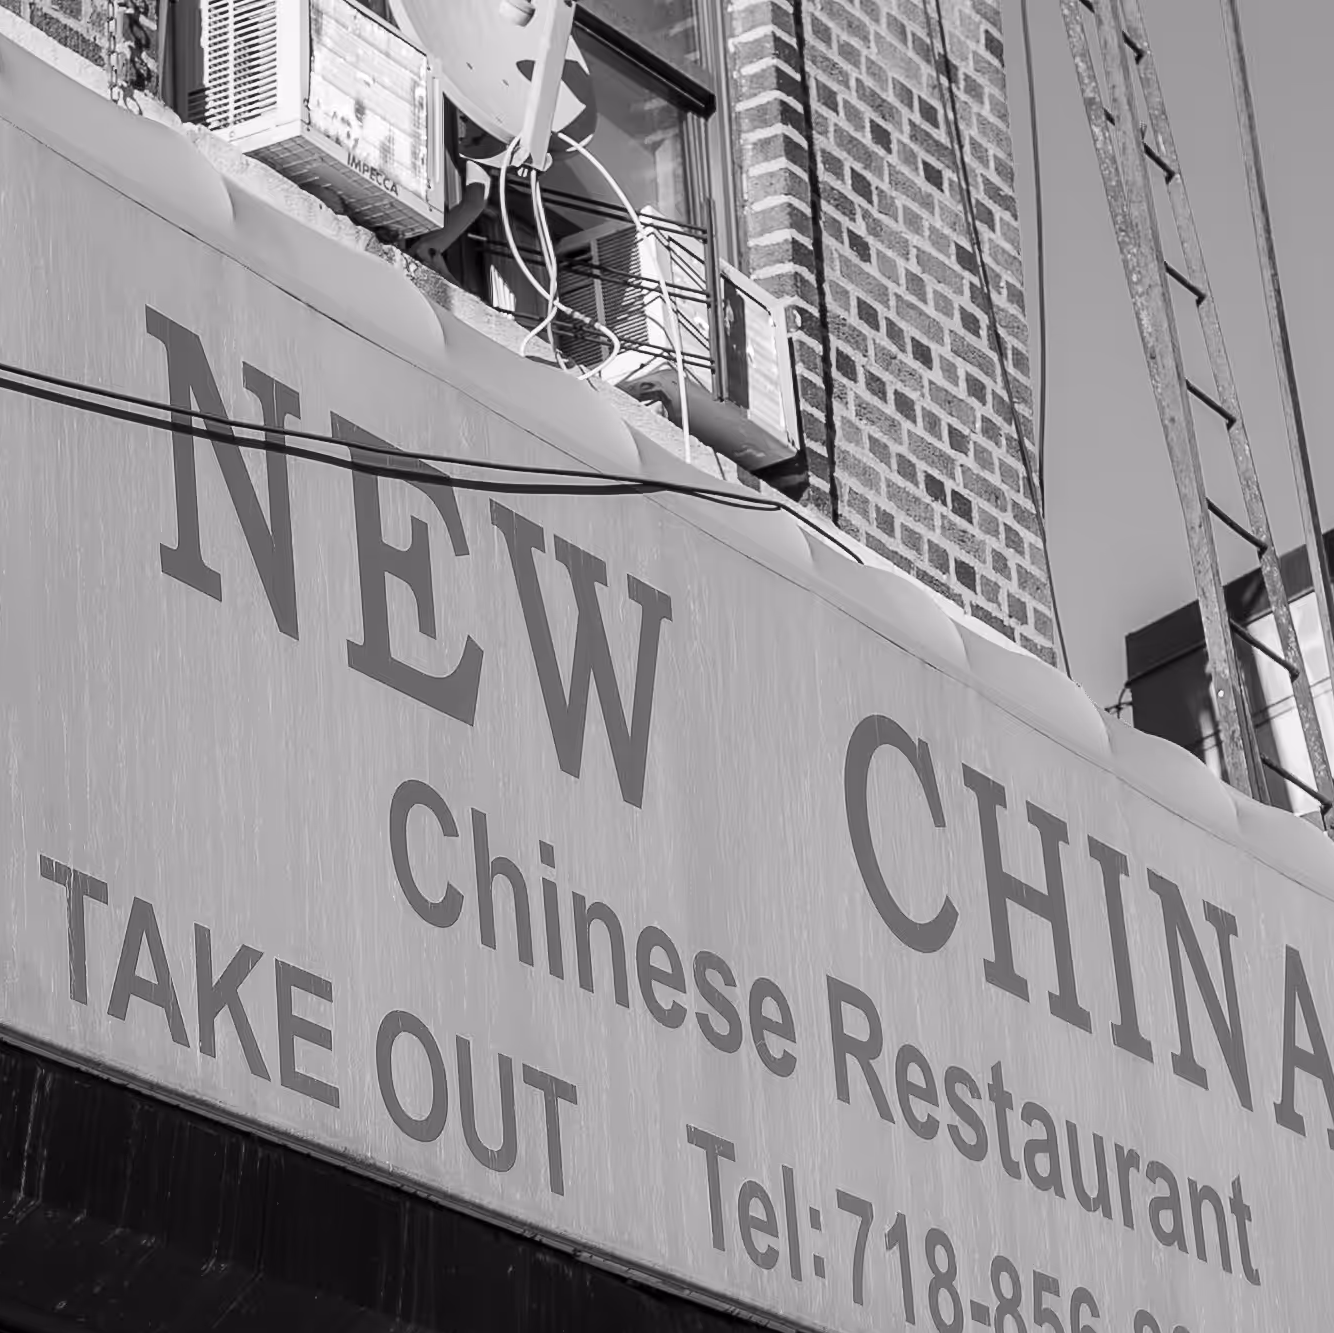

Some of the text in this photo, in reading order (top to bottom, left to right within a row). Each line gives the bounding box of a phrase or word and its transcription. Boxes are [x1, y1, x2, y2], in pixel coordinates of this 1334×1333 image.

[347, 151, 399, 197] IMPECCA
[145, 305, 673, 810] NEW
[39, 853, 578, 1197] TAKE OUT
[387, 779, 1261, 1287] Chinese Restaurant
